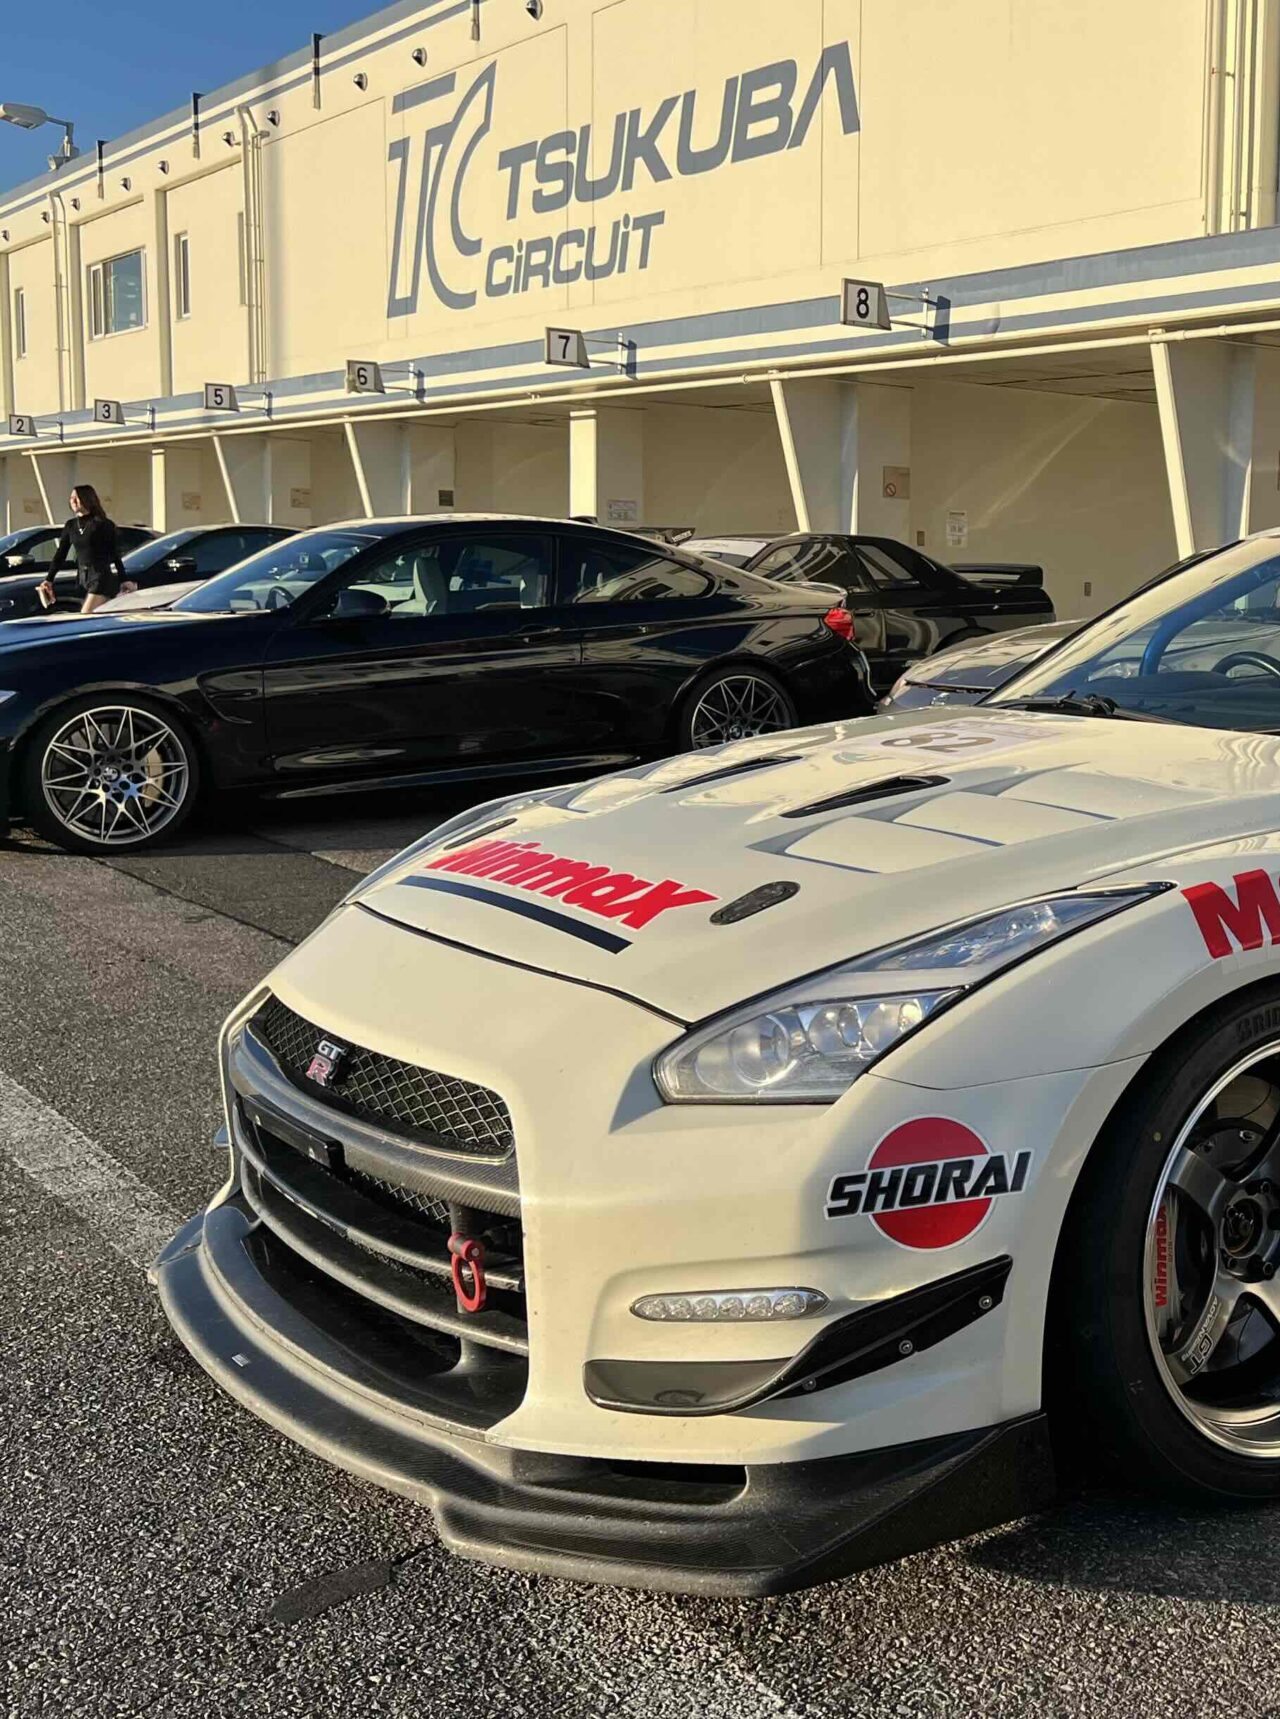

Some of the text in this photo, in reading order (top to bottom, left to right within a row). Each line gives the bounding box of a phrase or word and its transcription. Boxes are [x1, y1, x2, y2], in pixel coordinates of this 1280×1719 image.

[497, 40, 861, 221] TSUKUBA
[855, 287, 870, 319] 8
[557, 334, 571, 360] 7
[356, 366, 368, 386] 6
[213, 388, 224, 406] 5
[101, 404, 112, 419] 3
[15, 418, 25, 433] 2
[826, 1150, 1032, 1219] SHORAI
